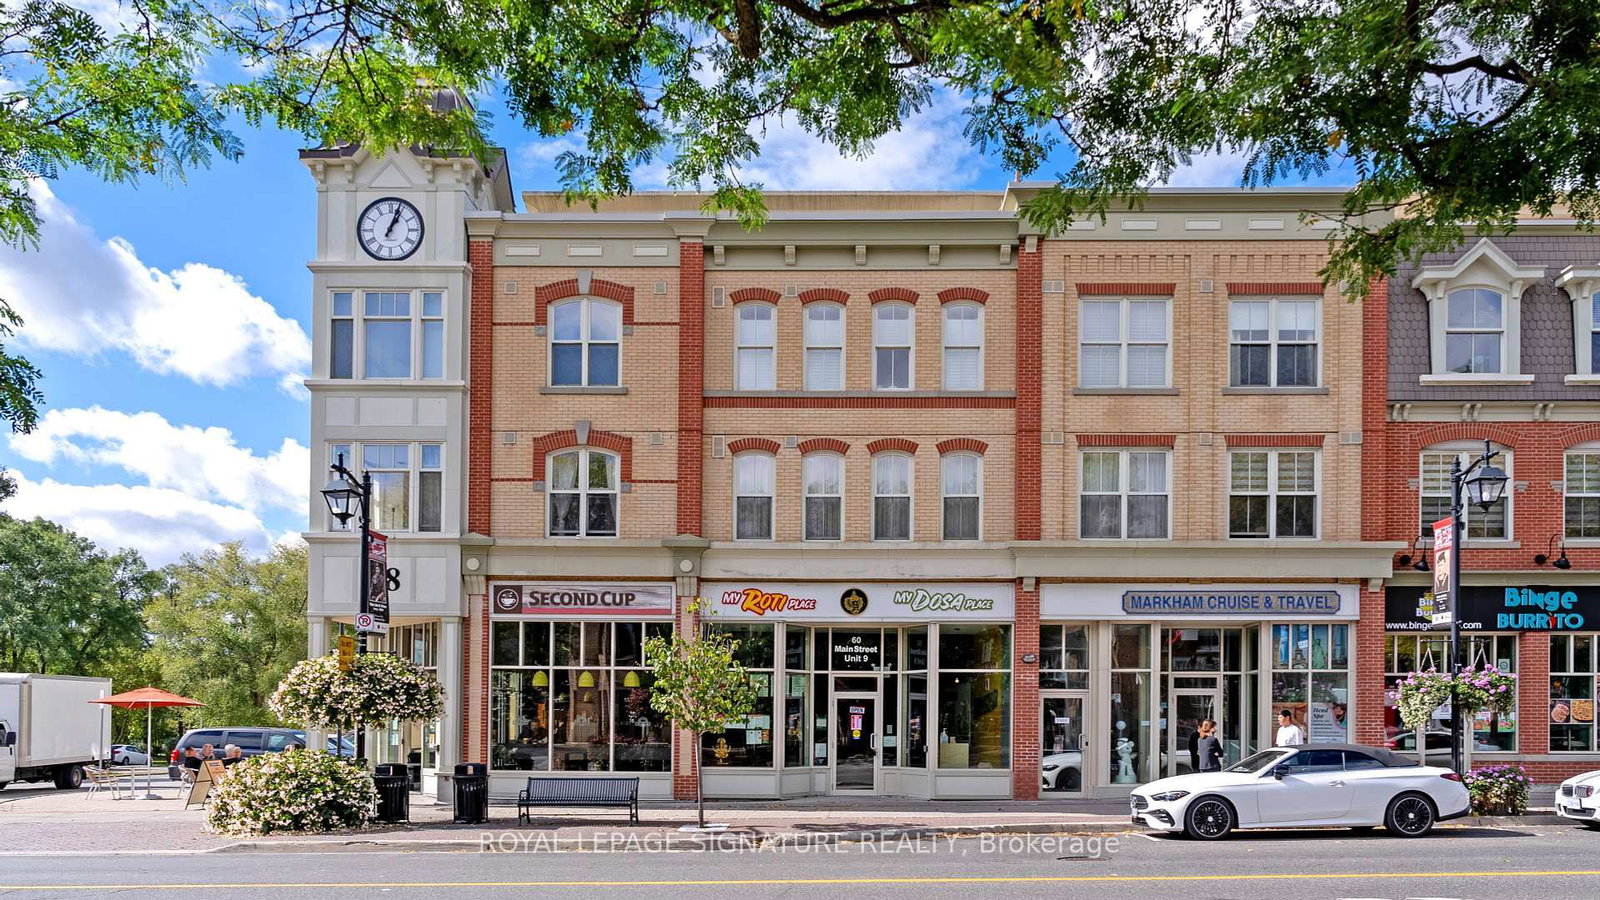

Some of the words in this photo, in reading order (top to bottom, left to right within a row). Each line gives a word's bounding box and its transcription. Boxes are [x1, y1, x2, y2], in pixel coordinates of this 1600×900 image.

[722, 591, 742, 604] MY
[741, 588, 788, 615] ROTI
[787, 598, 816, 610] PLACE
[893, 590, 914, 604] MY
[911, 589, 965, 611] DOSA
[964, 599, 993, 610] PLACE
[1131, 596, 1203, 609] MARKHAM
[1207, 595, 1260, 609] CRUISE
[1264, 596, 1273, 609] &
[1277, 596, 1332, 609] TRAVEL
[851, 636, 862, 644] 60
[834, 645, 853, 653] Main
[854, 645, 878, 653] Street
[844, 654, 861, 662] Unit
